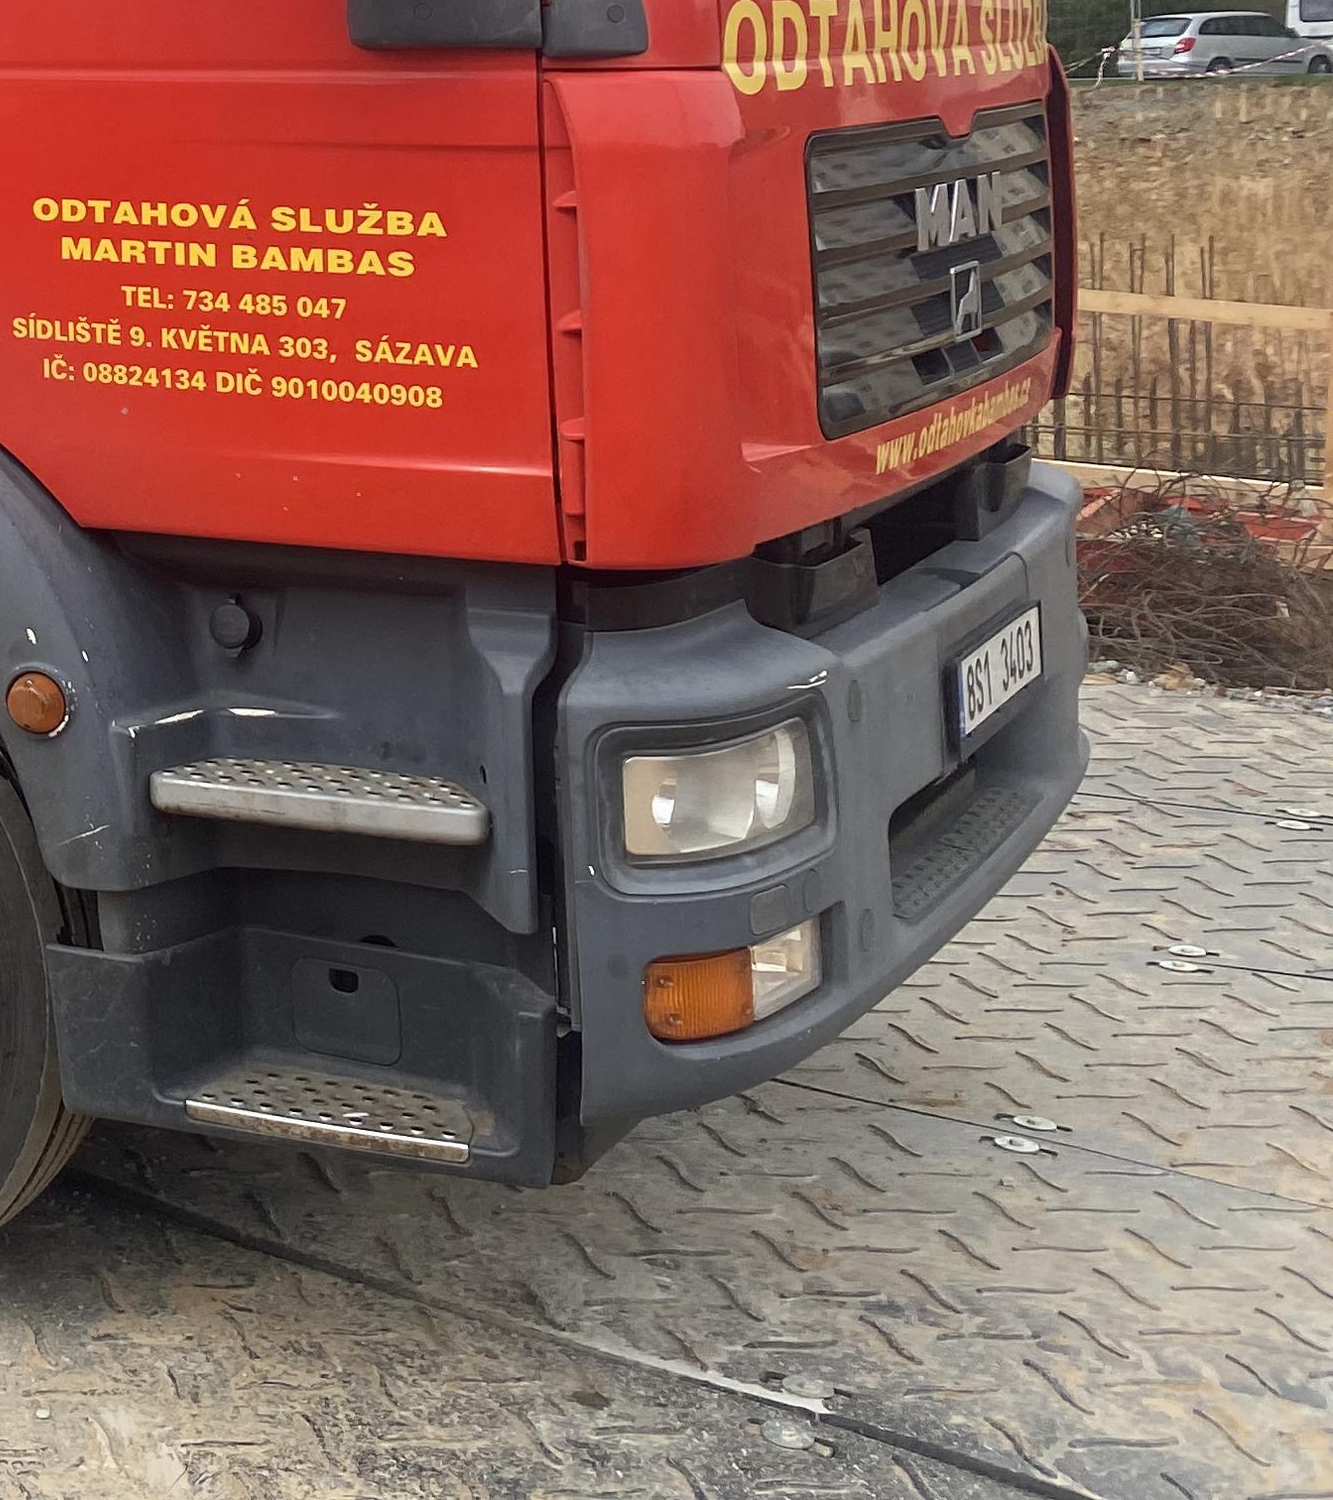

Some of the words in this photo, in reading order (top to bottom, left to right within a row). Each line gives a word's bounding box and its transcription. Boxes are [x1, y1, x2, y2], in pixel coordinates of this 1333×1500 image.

[32, 197, 257, 231] ODTAHOVÁ
[271, 202, 448, 238] SLUŽBA
[915, 171, 1003, 251] MAN
[61, 237, 216, 268] MARTIN
[232, 244, 416, 277] BAMBAS
[121, 285, 174, 310] TEL:
[182, 289, 231, 313] 734
[238, 293, 288, 316] 485
[296, 296, 347, 319] 047
[12, 312, 122, 346] SÍDLIŠTĚ
[129, 326, 152, 348] 9.
[161, 324, 271, 356] KVĚTNA
[278, 336, 338, 364] 303,
[355, 334, 479, 368] SÁZAVA
[43, 353, 75, 381] IČ:
[82, 362, 207, 391] 08824134
[216, 367, 262, 396] DIČ
[271, 376, 444, 408] 9010040908
[966, 650, 993, 721] 8S1
[1000, 620, 1034, 692] 3403
